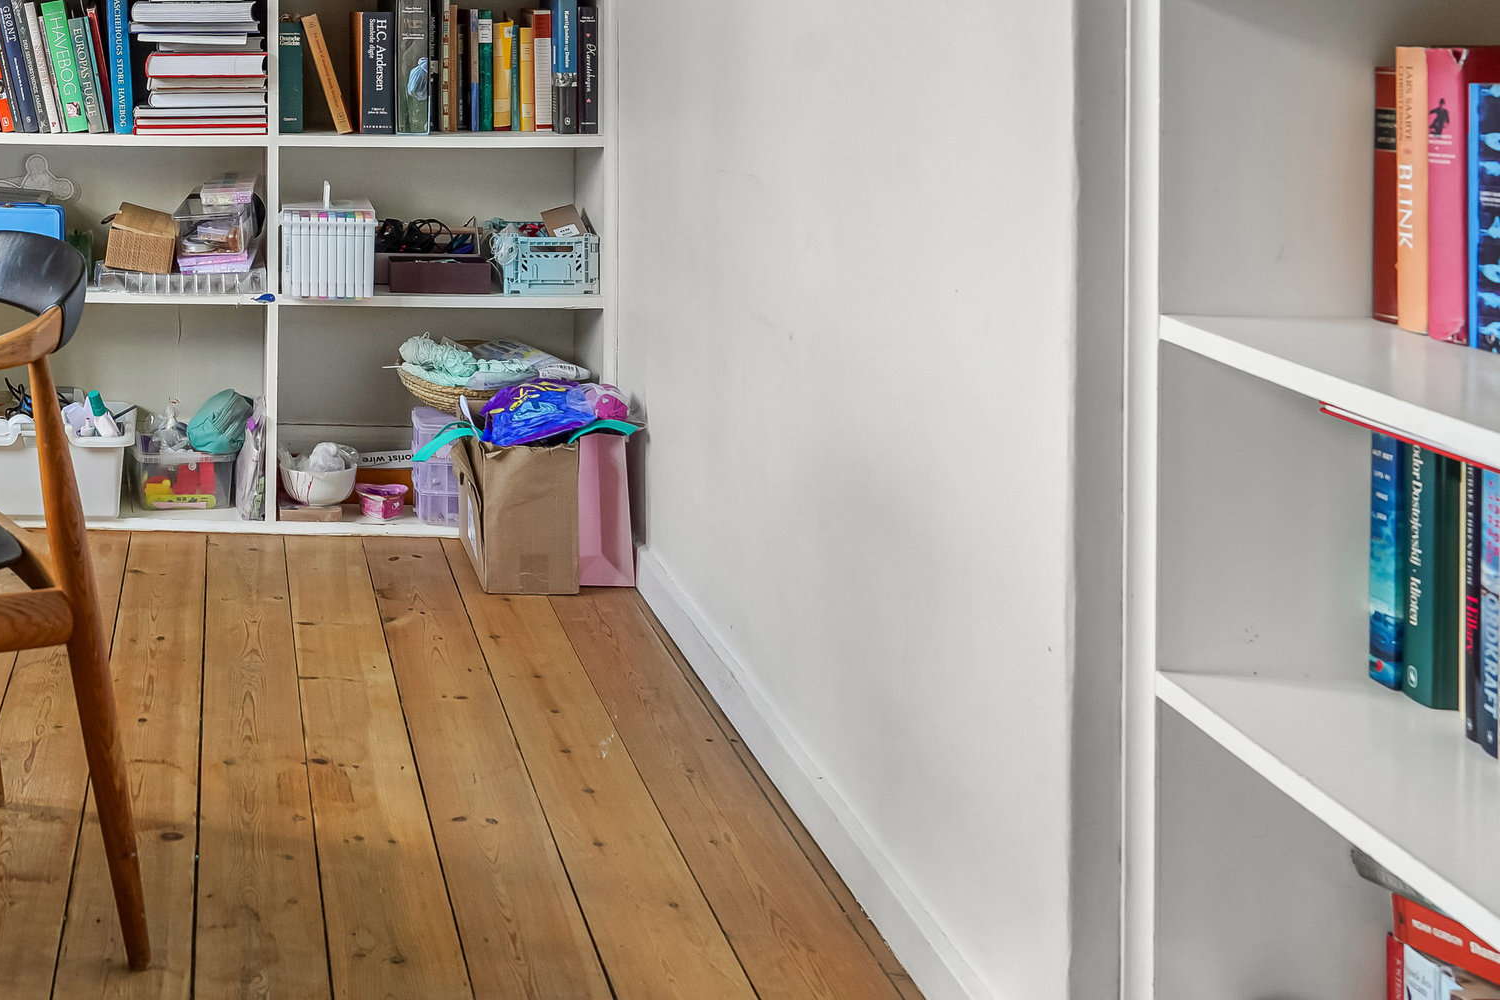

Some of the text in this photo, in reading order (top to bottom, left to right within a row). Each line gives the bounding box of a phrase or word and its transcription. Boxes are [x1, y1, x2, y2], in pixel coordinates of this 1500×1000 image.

[3, 6, 16, 41] GRØNT
[50, 19, 77, 96] HAVEBOG
[368, 42, 376, 59] digte
[376, 19, 387, 90] H.C. Andersen
[72, 28, 96, 117] EUROPAS FUGLE
[114, 0, 127, 127] ASCHEHOUGS STORE HAVEBOG
